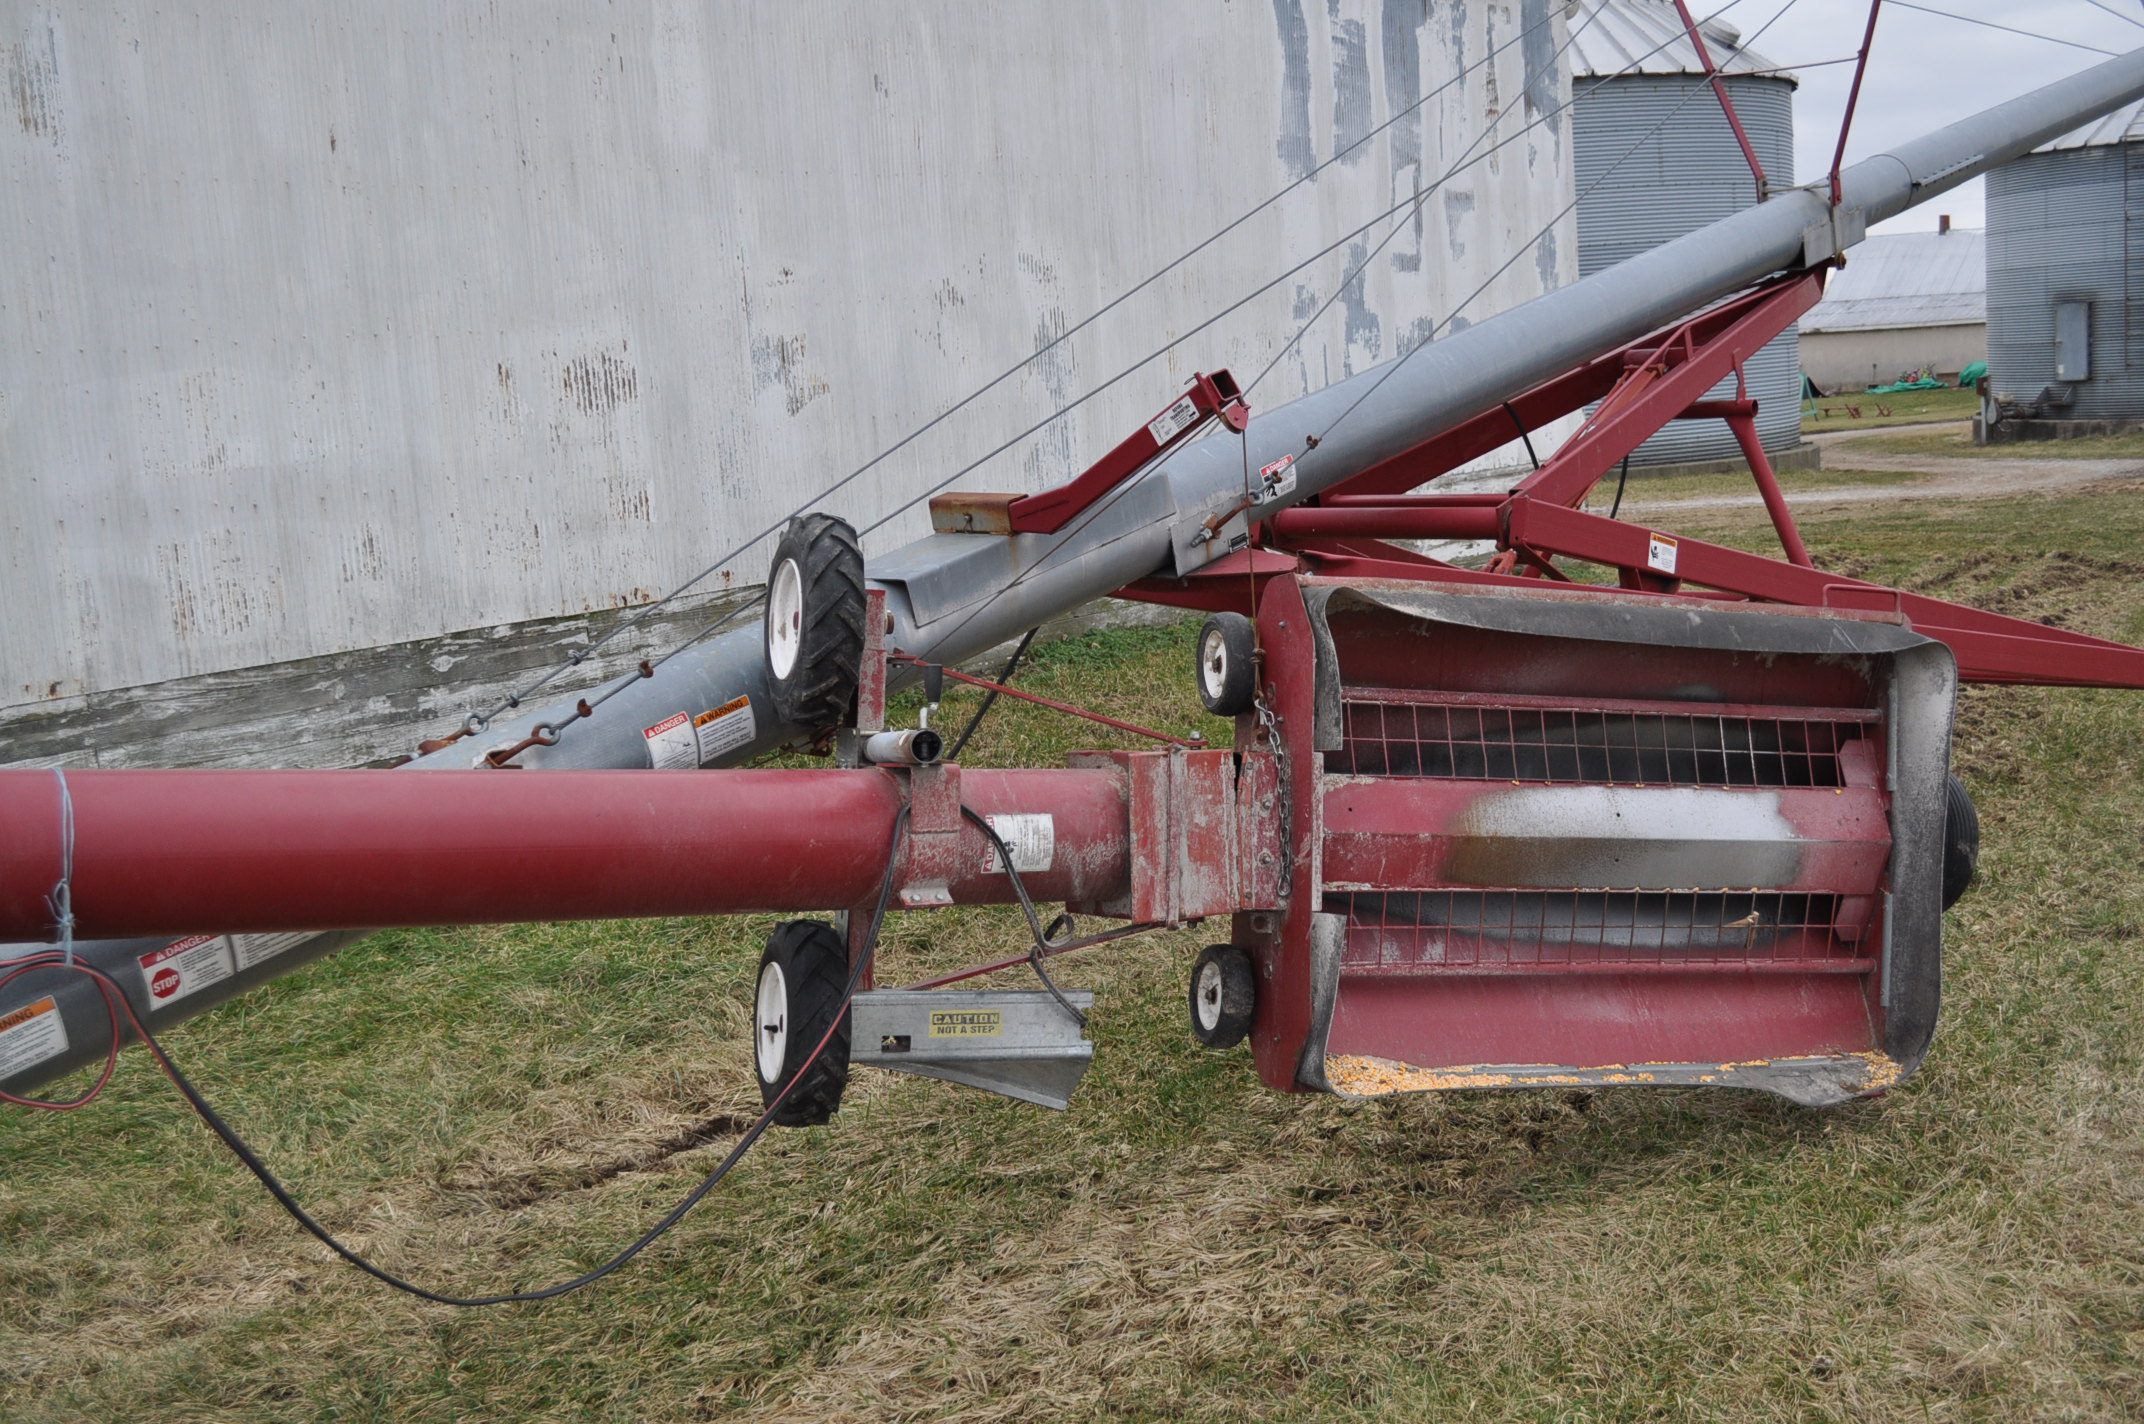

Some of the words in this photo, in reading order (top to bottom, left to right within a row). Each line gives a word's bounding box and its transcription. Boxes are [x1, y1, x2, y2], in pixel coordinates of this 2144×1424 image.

[708, 700, 743, 721] WARNING
[655, 716, 686, 734] DANGER
[986, 818, 994, 860] DANR
[165, 935, 210, 957] DANGER
[153, 974, 179, 993] STOP
[933, 1014, 998, 1024] CAUTION
[937, 1025, 957, 1034] NOT
[960, 1025, 967, 1034] A
[970, 1025, 995, 1034] STEP
